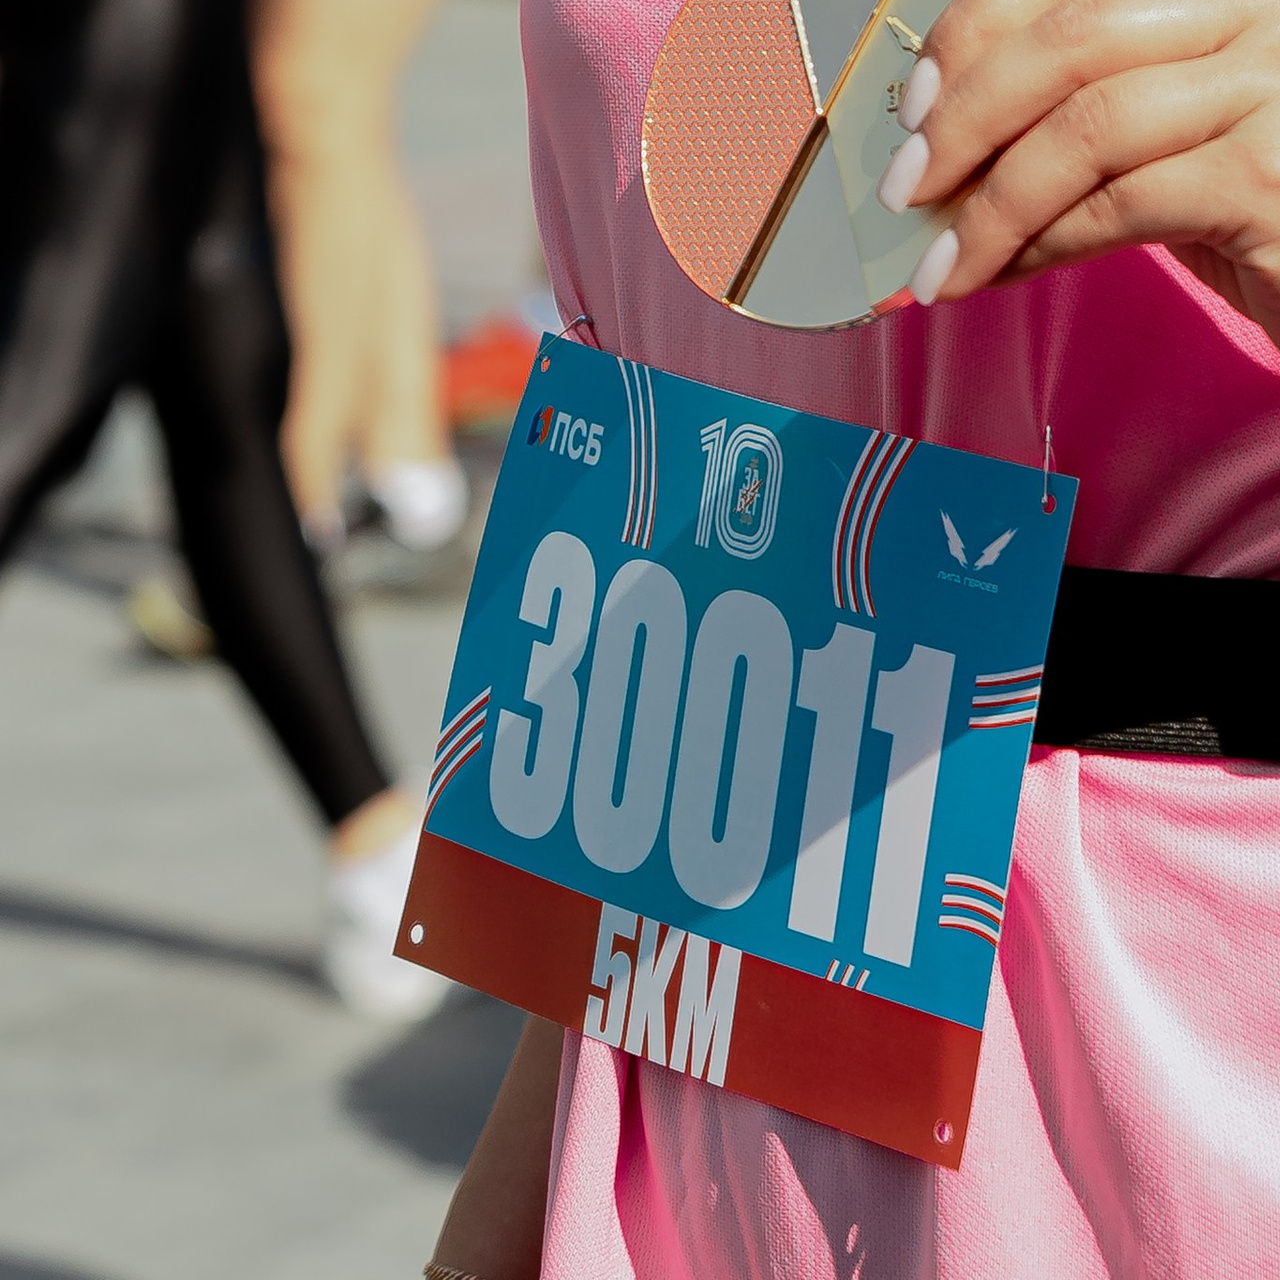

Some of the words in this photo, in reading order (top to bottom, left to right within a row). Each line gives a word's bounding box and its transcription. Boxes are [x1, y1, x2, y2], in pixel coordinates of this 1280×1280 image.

[549, 411, 605, 466] ПСБ
[695, 418, 783, 560] 10
[489, 531, 957, 969] 30011
